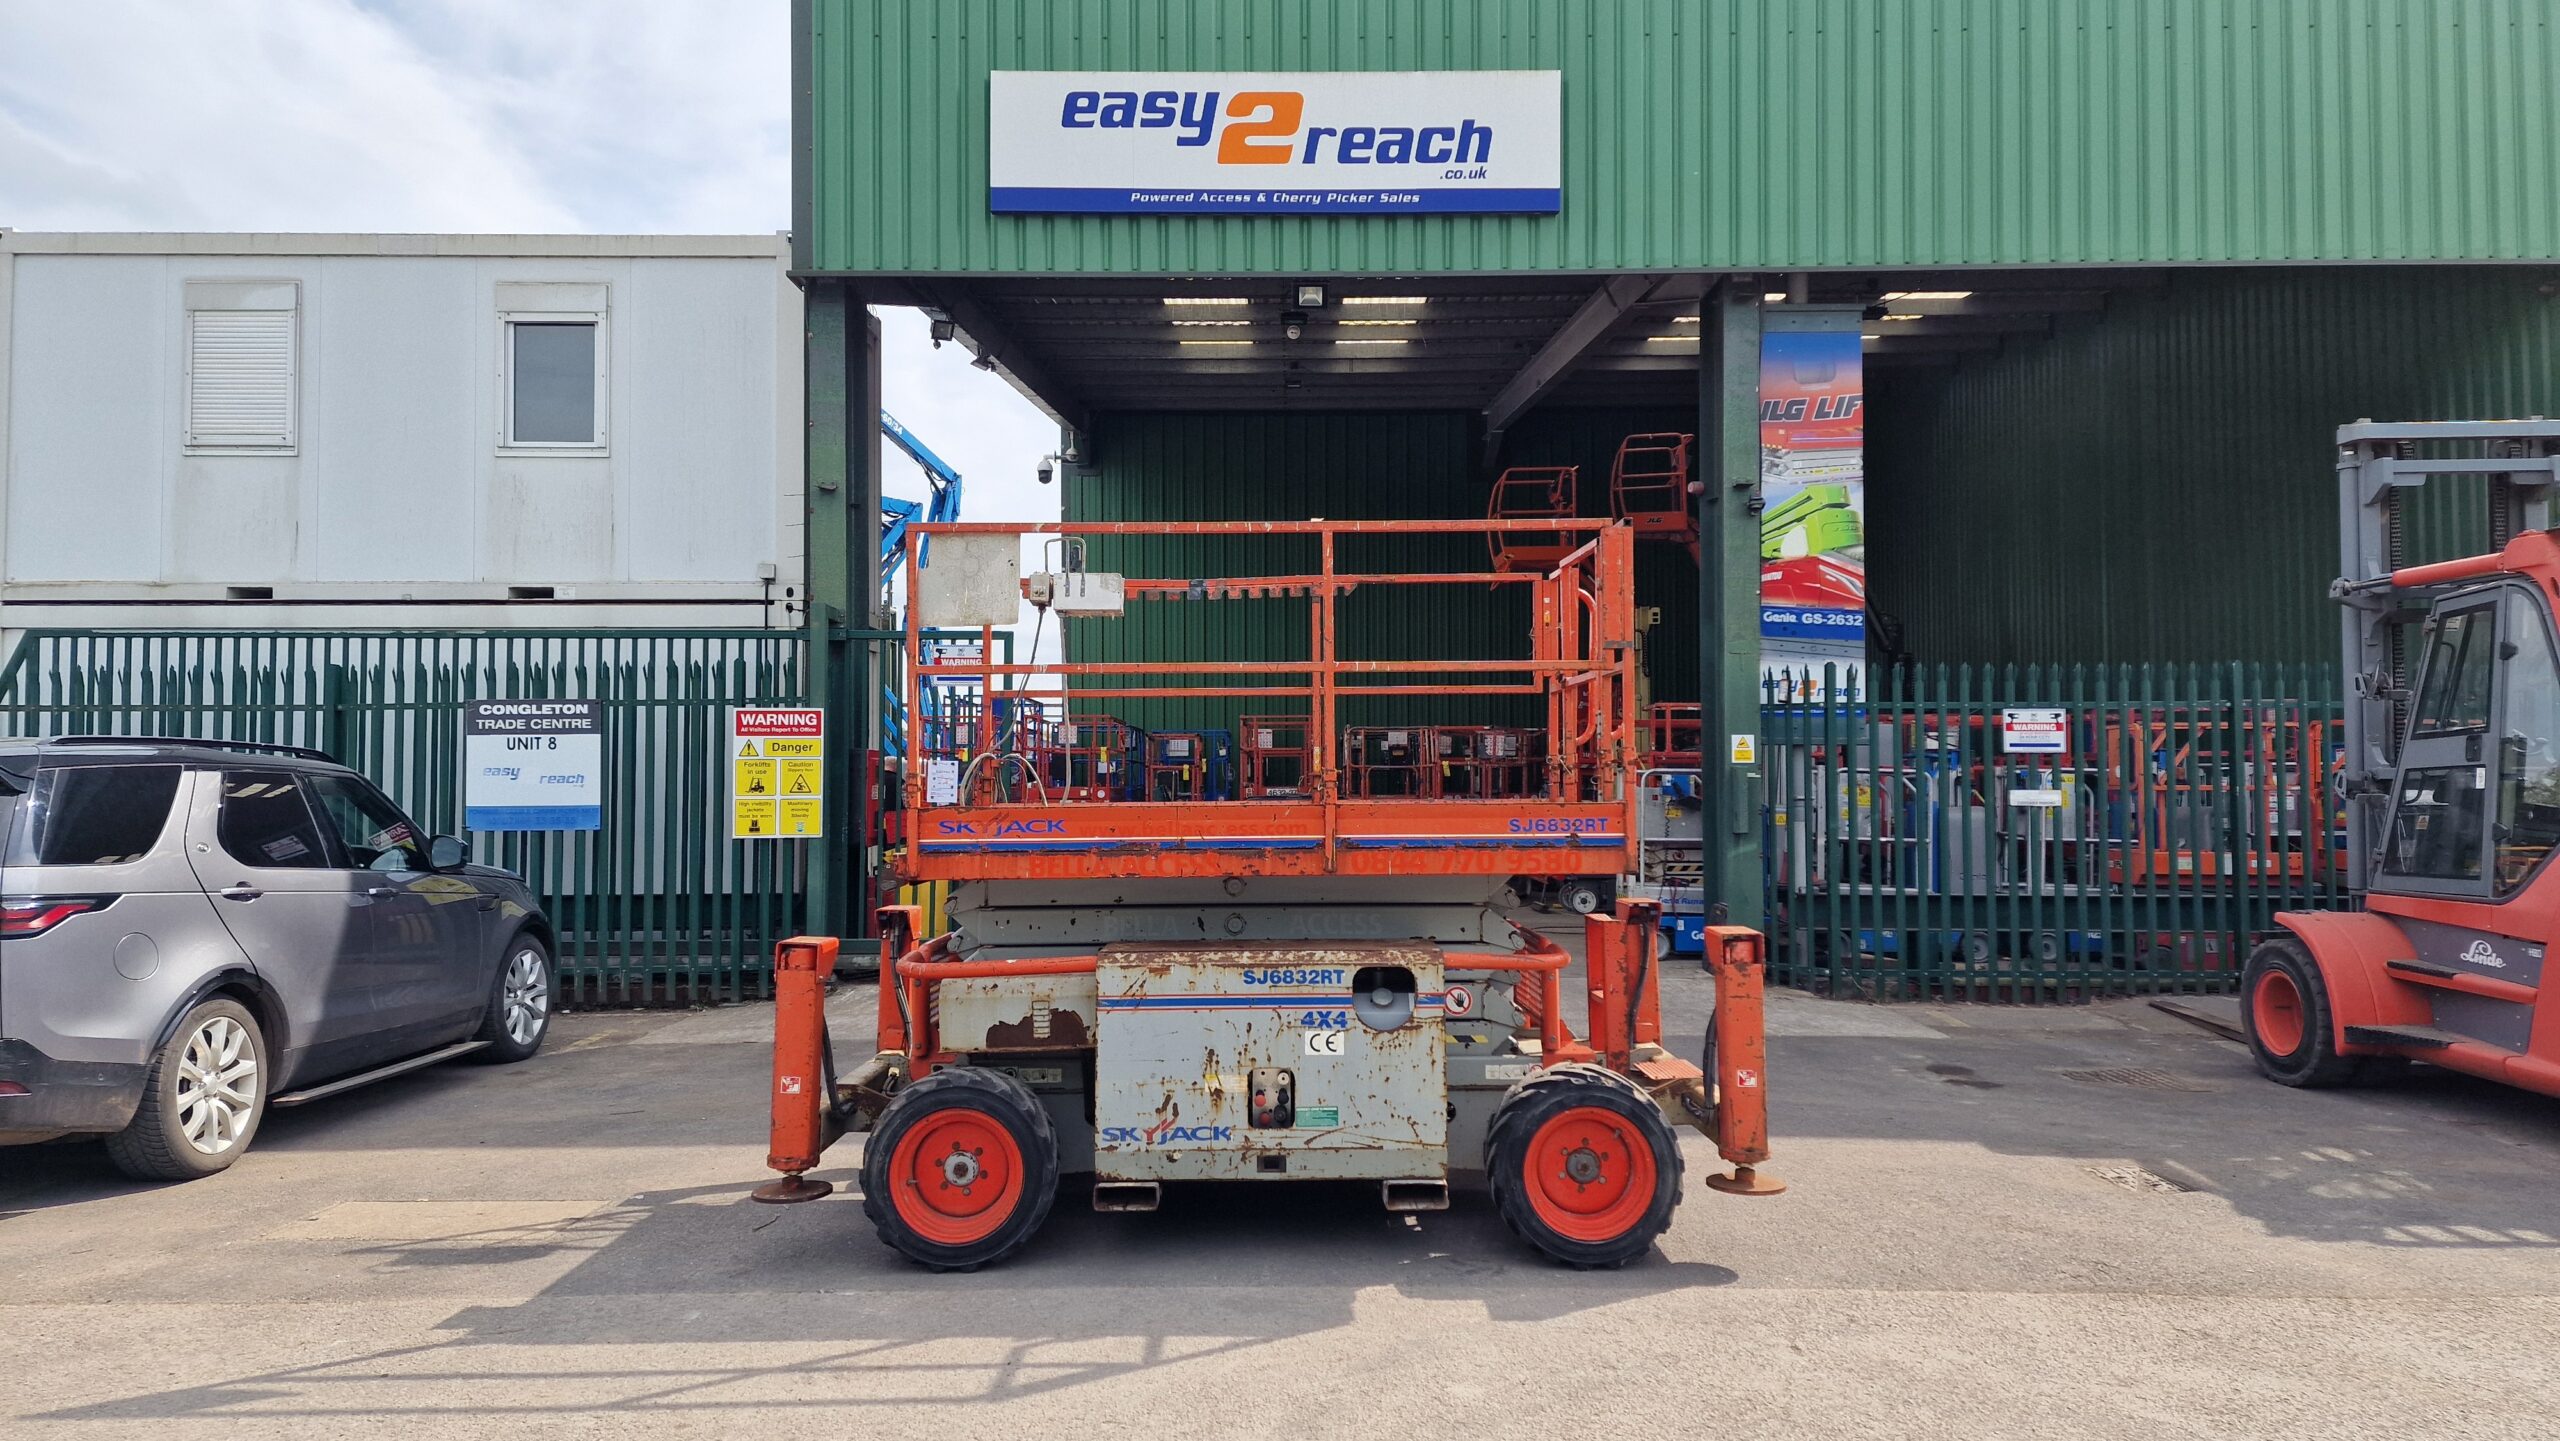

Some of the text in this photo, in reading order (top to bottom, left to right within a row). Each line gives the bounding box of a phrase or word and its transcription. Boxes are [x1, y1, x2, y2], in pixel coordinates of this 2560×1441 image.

[1439, 166, 1487, 181] .co.uk
[1131, 192, 1420, 206] Powered Access & Cherry Picker Sales
[1763, 611, 1863, 626] Genie GS-2632
[941, 658, 982, 666] WARNING
[479, 704, 589, 715] CONGLETON
[476, 718, 592, 730] TRADE CENTRE
[740, 713, 817, 726] WARNING
[2013, 723, 2057, 731] WARNING
[506, 736, 557, 750] UNIT 8
[772, 742, 813, 753] Danger
[483, 767, 585, 784] easy reach
[938, 815, 1067, 837] SKYJACK
[1510, 818, 1608, 832] SJ6832RT
[2460, 940, 2507, 968] Linde
[1243, 969, 1345, 985] SJ6832RT
[1300, 1011, 1348, 1029] 4X4
[1102, 1116, 1232, 1145] SKYJACK
